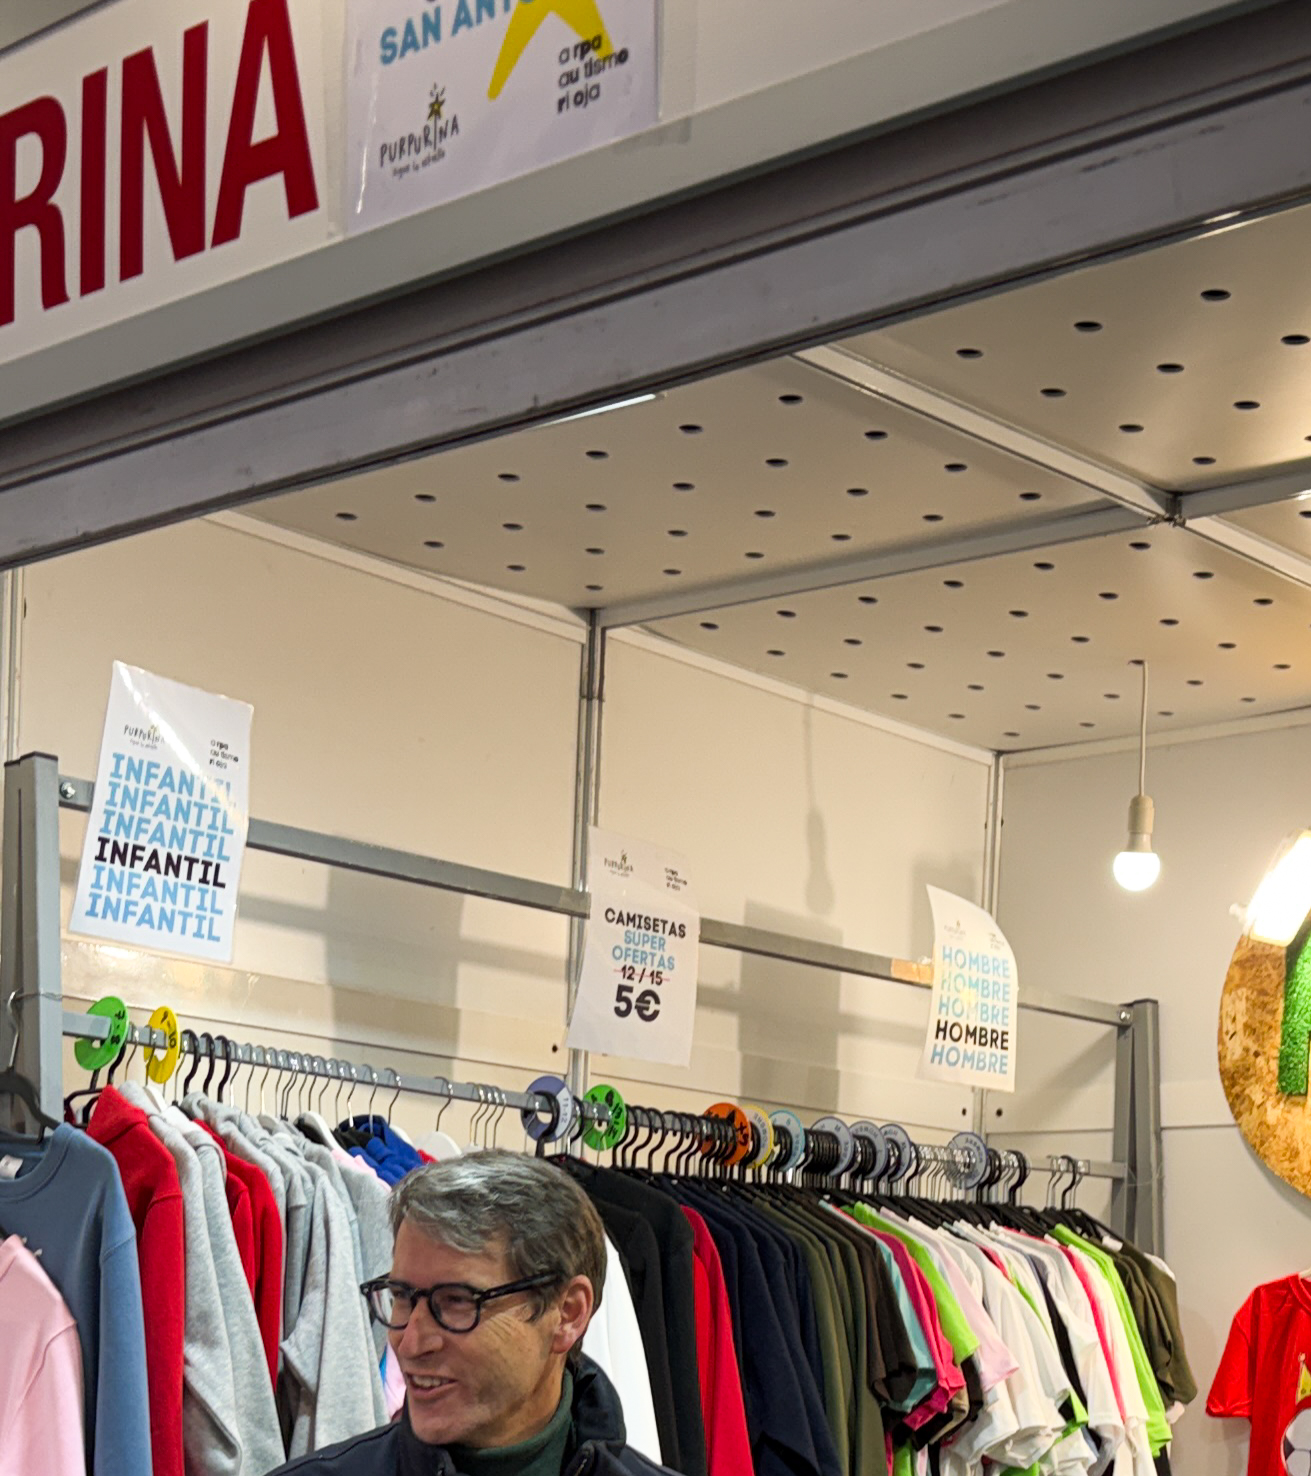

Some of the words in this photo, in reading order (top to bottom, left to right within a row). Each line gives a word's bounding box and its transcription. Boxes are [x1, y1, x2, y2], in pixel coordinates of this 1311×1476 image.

[380, 5, 441, 65] SAN
[379, 114, 460, 167] PURPURINA
[106, 781, 234, 834] INFANTIL
[99, 809, 231, 862] INFANTIL
[94, 836, 226, 888] INFANTIL
[90, 864, 224, 914] INFANTIL
[85, 892, 220, 942] INFANTIL
[605, 907, 686, 939] CAMISETAS
[612, 945, 675, 971] OFERTAS
[624, 929, 665, 952] SUPER
[621, 965, 635, 981] 12
[649, 969, 663, 986] 15
[942, 945, 1011, 979] HOMBRE
[614, 984, 660, 1022] 5€
[940, 970, 1010, 1002] HOMBRE
[935, 1019, 1008, 1051] HOMBRE
[930, 1043, 1008, 1075] HOMBRE
